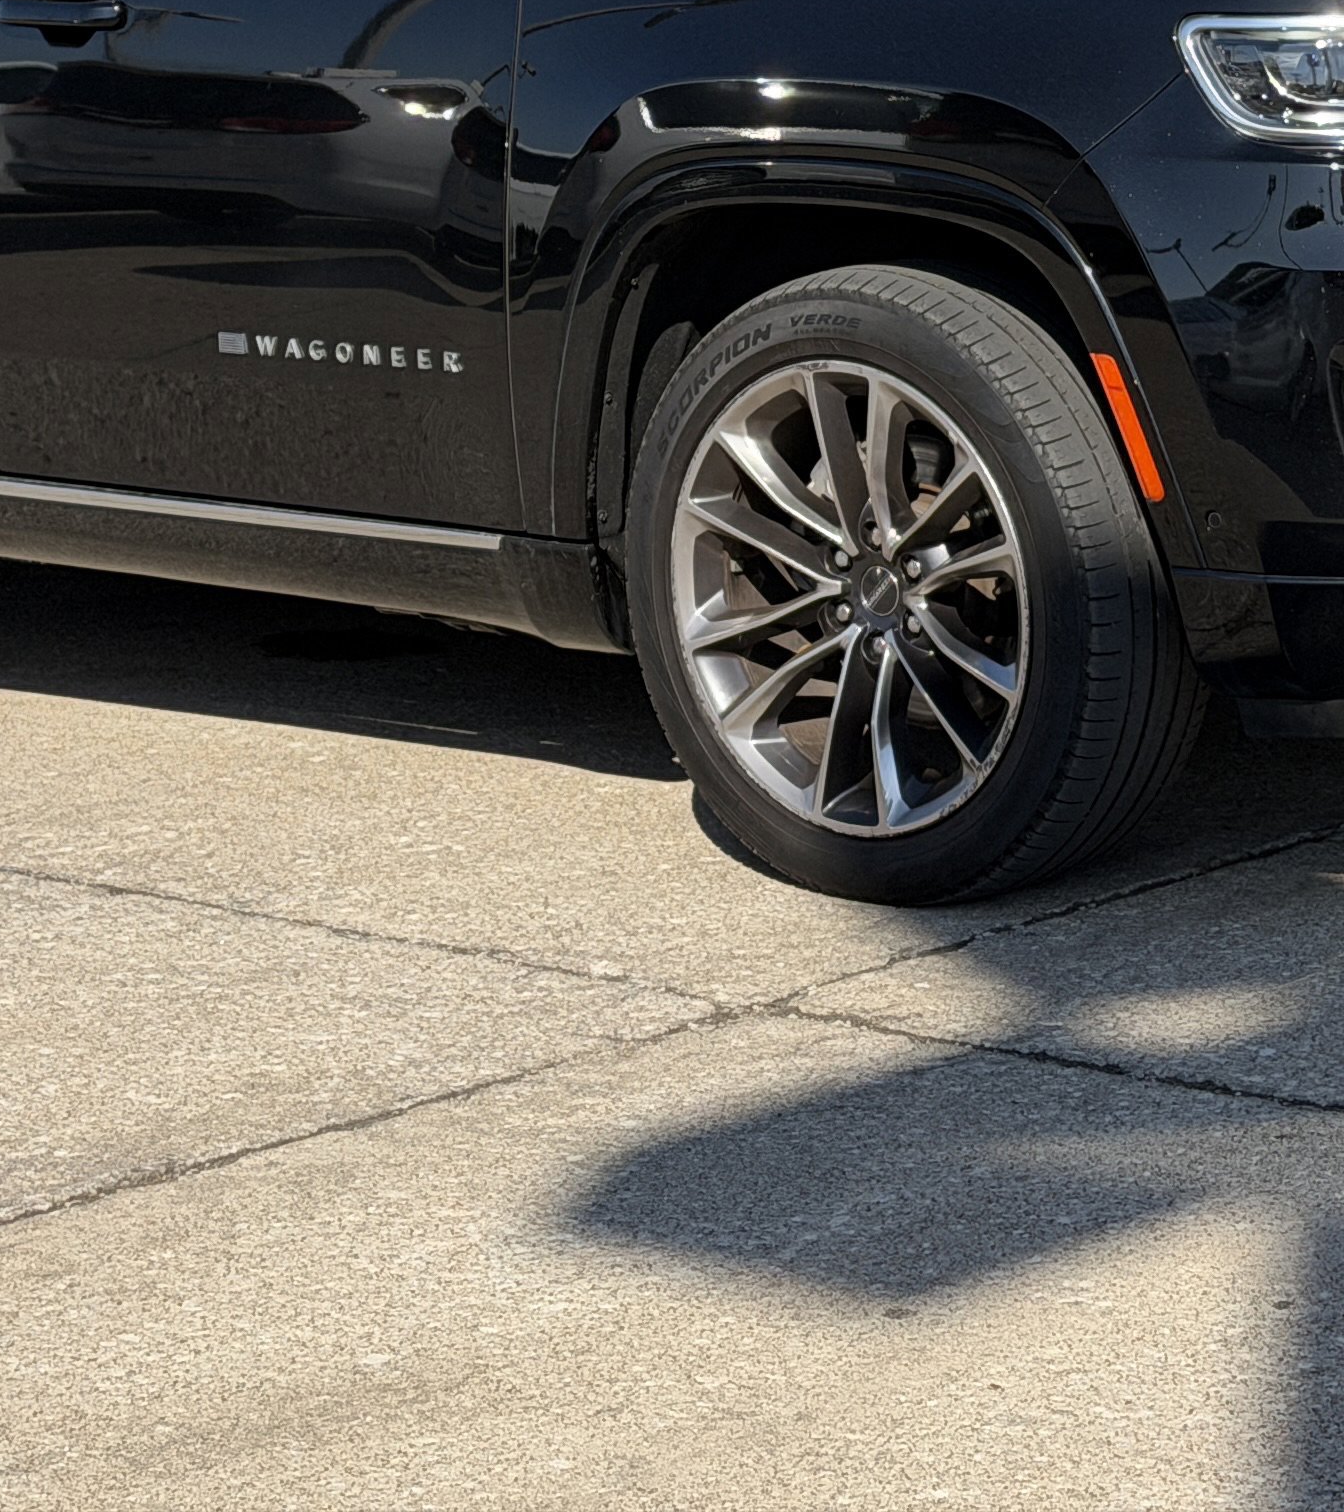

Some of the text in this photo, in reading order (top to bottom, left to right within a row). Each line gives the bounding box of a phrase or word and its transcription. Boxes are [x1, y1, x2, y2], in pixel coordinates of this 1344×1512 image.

[256, 335, 464, 373] WAGONEER
[657, 312, 863, 459] SCORPION VERDE
